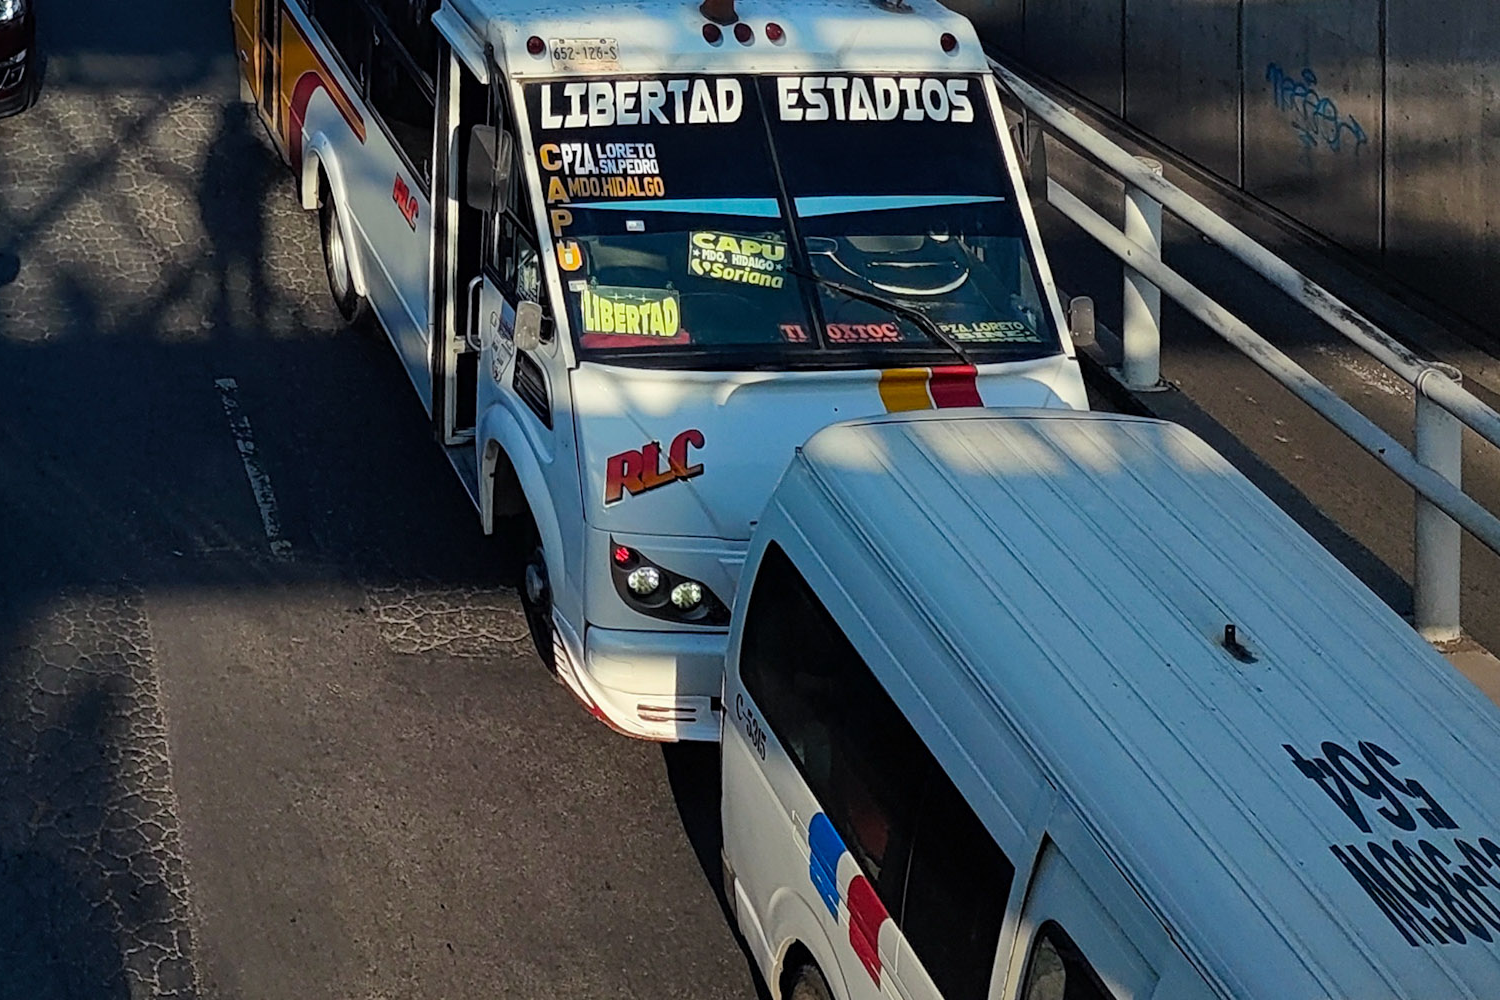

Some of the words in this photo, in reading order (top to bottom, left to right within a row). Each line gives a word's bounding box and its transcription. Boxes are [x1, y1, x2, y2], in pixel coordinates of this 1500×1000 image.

[553, 47, 617, 60] 652-126-S
[541, 78, 743, 129] LIBERTAD
[777, 76, 974, 123] ESTADIOS
[560, 143, 599, 175] PZA.
[596, 143, 656, 158] LORETO
[692, 232, 785, 261] CAPU
[701, 249, 728, 264] MDO.
[731, 253, 775, 272] HIDALGO
[710, 262, 784, 289] Soriana
[583, 289, 679, 337] LIBERTAD
[972, 321, 1025, 332] LORETO
[604, 428, 706, 507] RLC
[1281, 740, 1461, 834] 564
